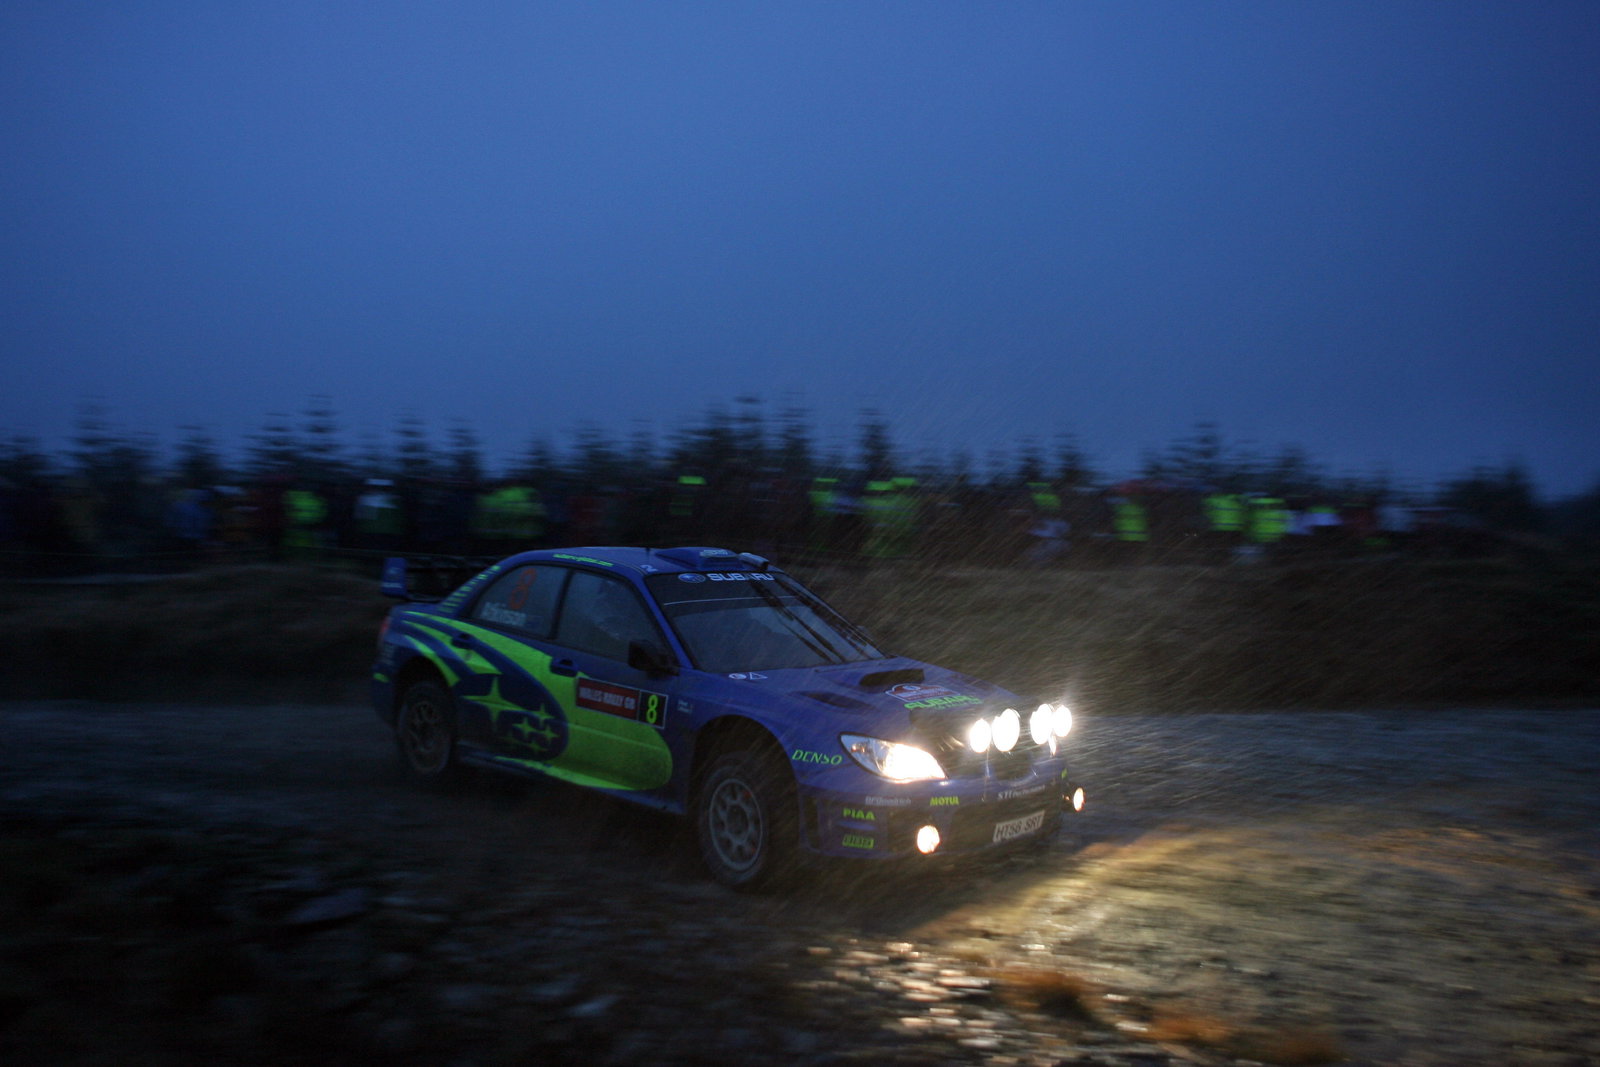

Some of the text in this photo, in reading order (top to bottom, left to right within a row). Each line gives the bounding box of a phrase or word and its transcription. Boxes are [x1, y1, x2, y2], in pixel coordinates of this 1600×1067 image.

[509, 568, 537, 610] 8
[646, 694, 659, 724] 8
[792, 749, 843, 765] DENSO
[930, 796, 960, 806] MOTUL
[843, 808, 876, 821] PIAA
